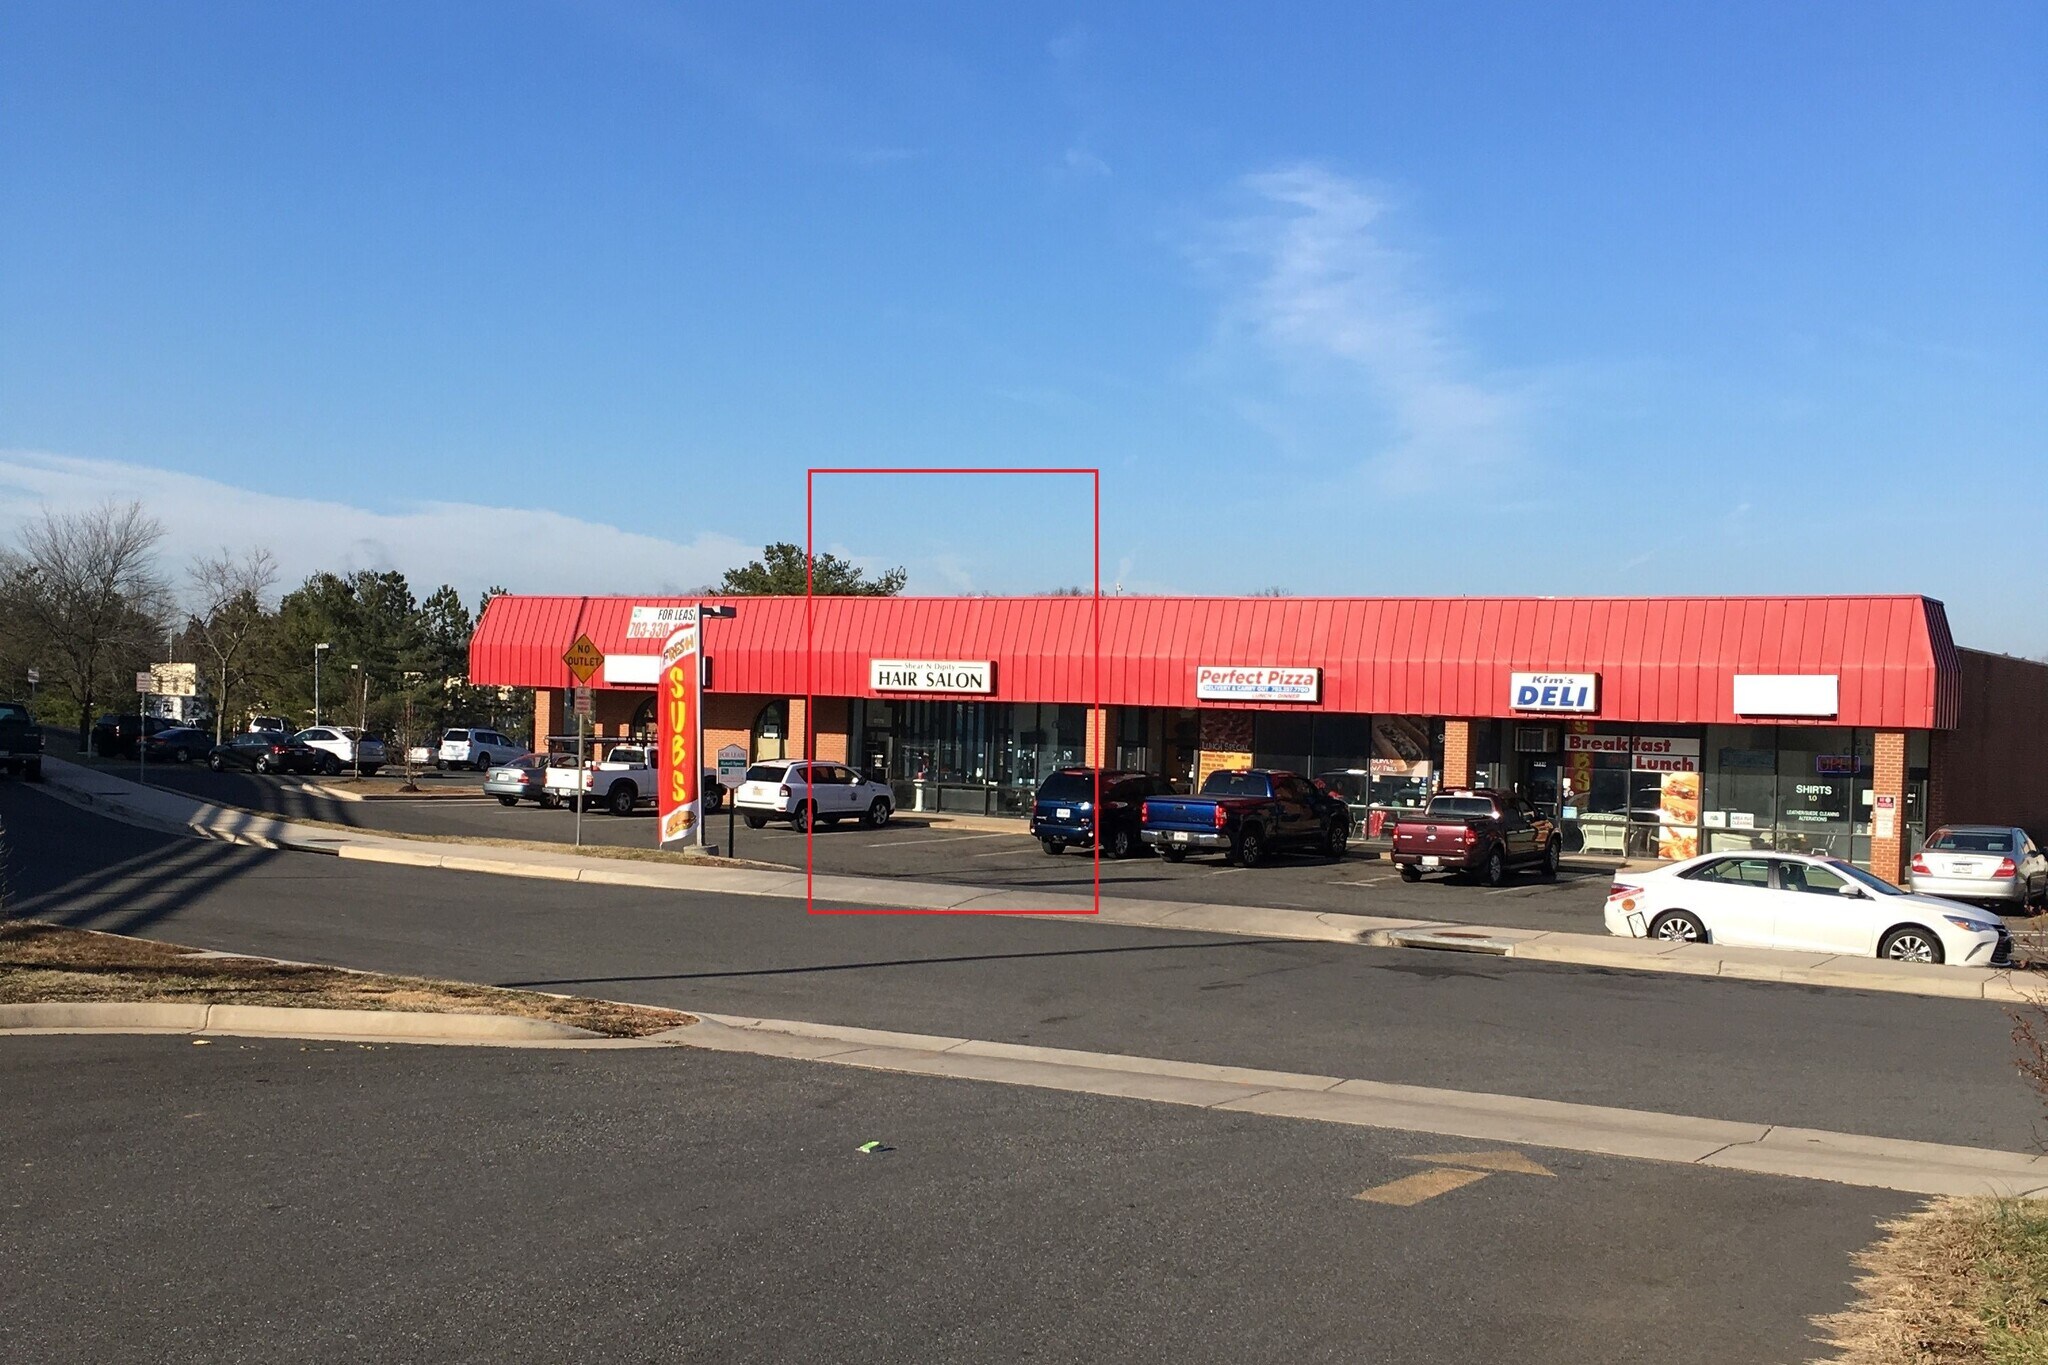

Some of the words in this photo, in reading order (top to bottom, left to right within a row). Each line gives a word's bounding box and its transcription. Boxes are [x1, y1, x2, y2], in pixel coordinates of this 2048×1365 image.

[658, 609, 673, 620] FOR
[577, 644, 590, 653] NO
[568, 657, 599, 666] OUTLET
[878, 671, 917, 686] HAIR
[926, 672, 983, 688] SALON
[1200, 669, 1263, 684] Perfect
[1267, 670, 1314, 685] Pizza
[1532, 676, 1574, 684] Kim's
[1517, 686, 1588, 706] DELI
[670, 666, 686, 802] SUBS
[1569, 736, 1671, 752] Breakfast
[1636, 756, 1694, 771] Lunch
[1795, 785, 1832, 795] SHIRTS
